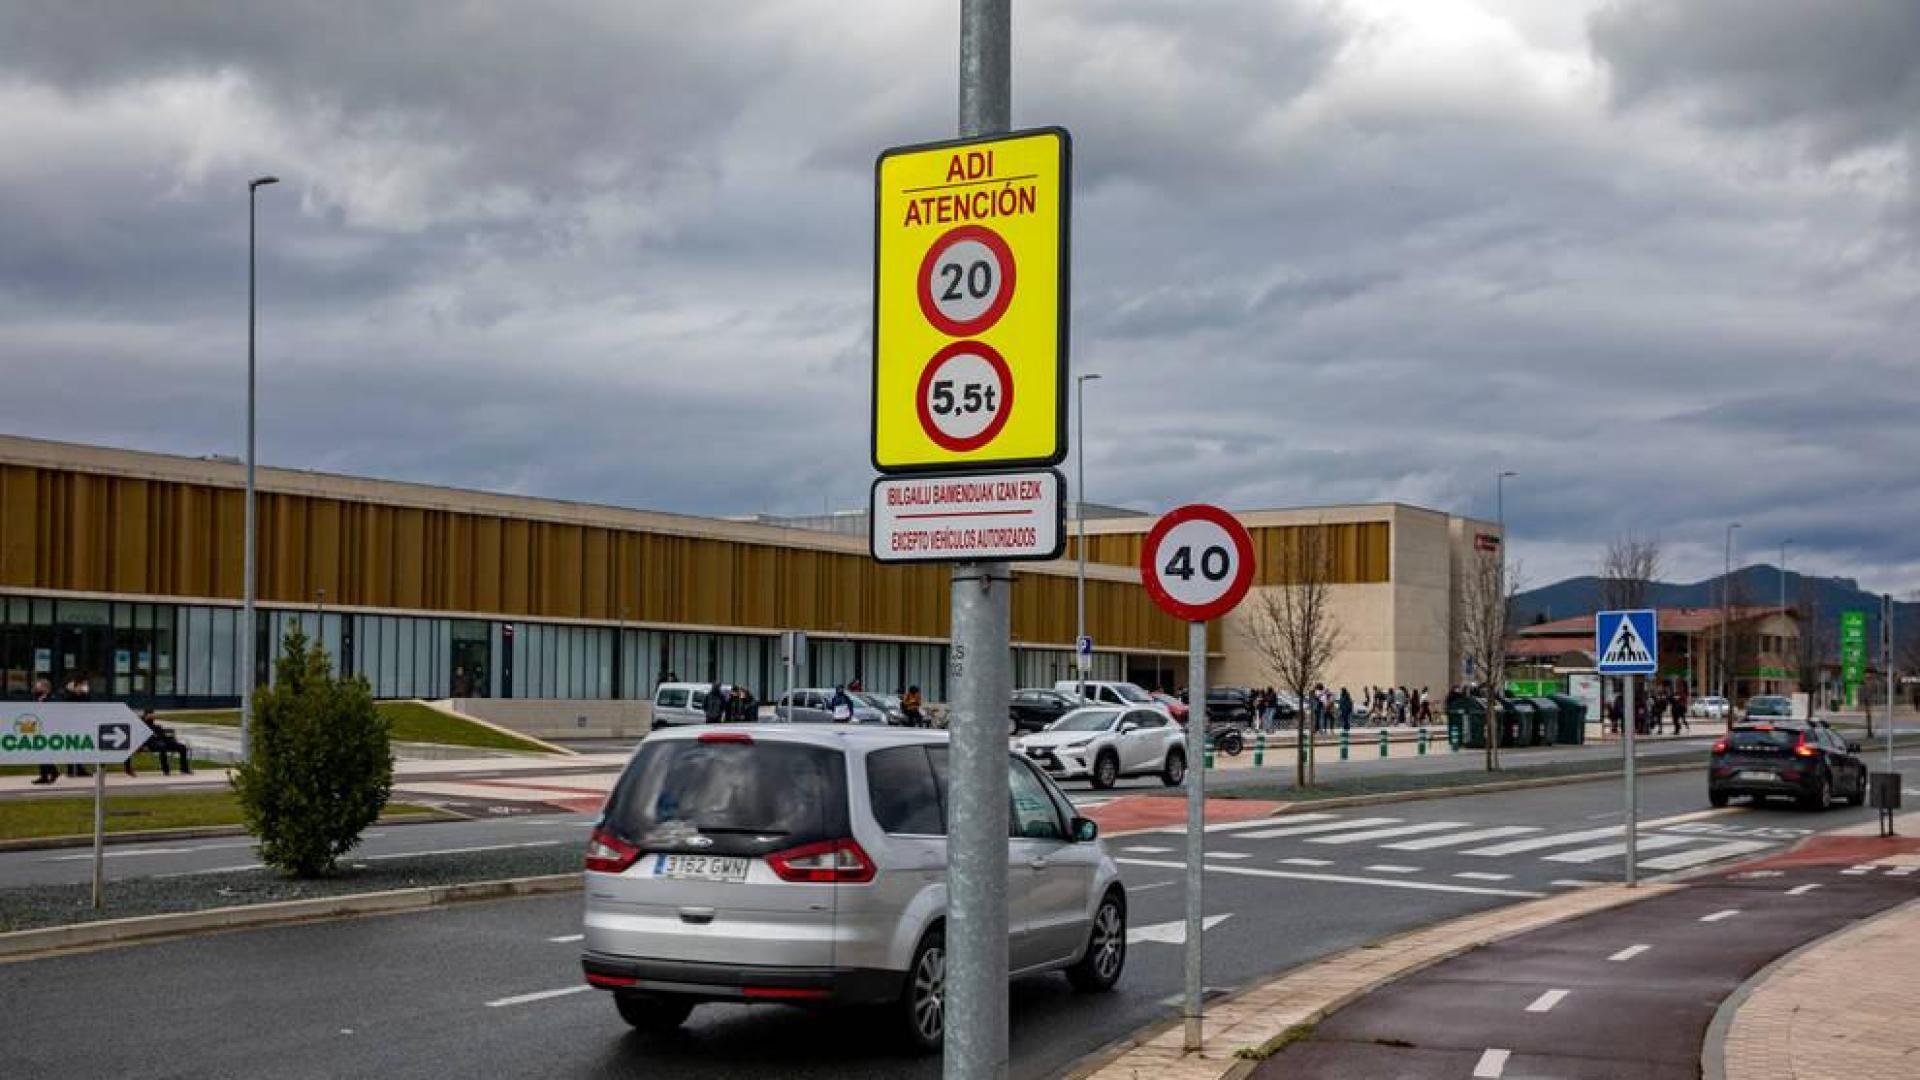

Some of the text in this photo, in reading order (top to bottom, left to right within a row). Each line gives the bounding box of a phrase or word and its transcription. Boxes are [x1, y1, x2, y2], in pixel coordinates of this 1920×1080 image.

[946, 151, 994, 182] ADI
[903, 182, 1037, 226] ATENCIÓN
[940, 260, 992, 300] 20
[932, 380, 996, 416] 5,5t
[996, 481, 1018, 500] IZAN
[1019, 480, 1042, 500] EZIK
[891, 526, 1036, 551] EXCEPTO VEHÍCULOS AUTORIZADOS
[1164, 545, 1230, 581] 40
